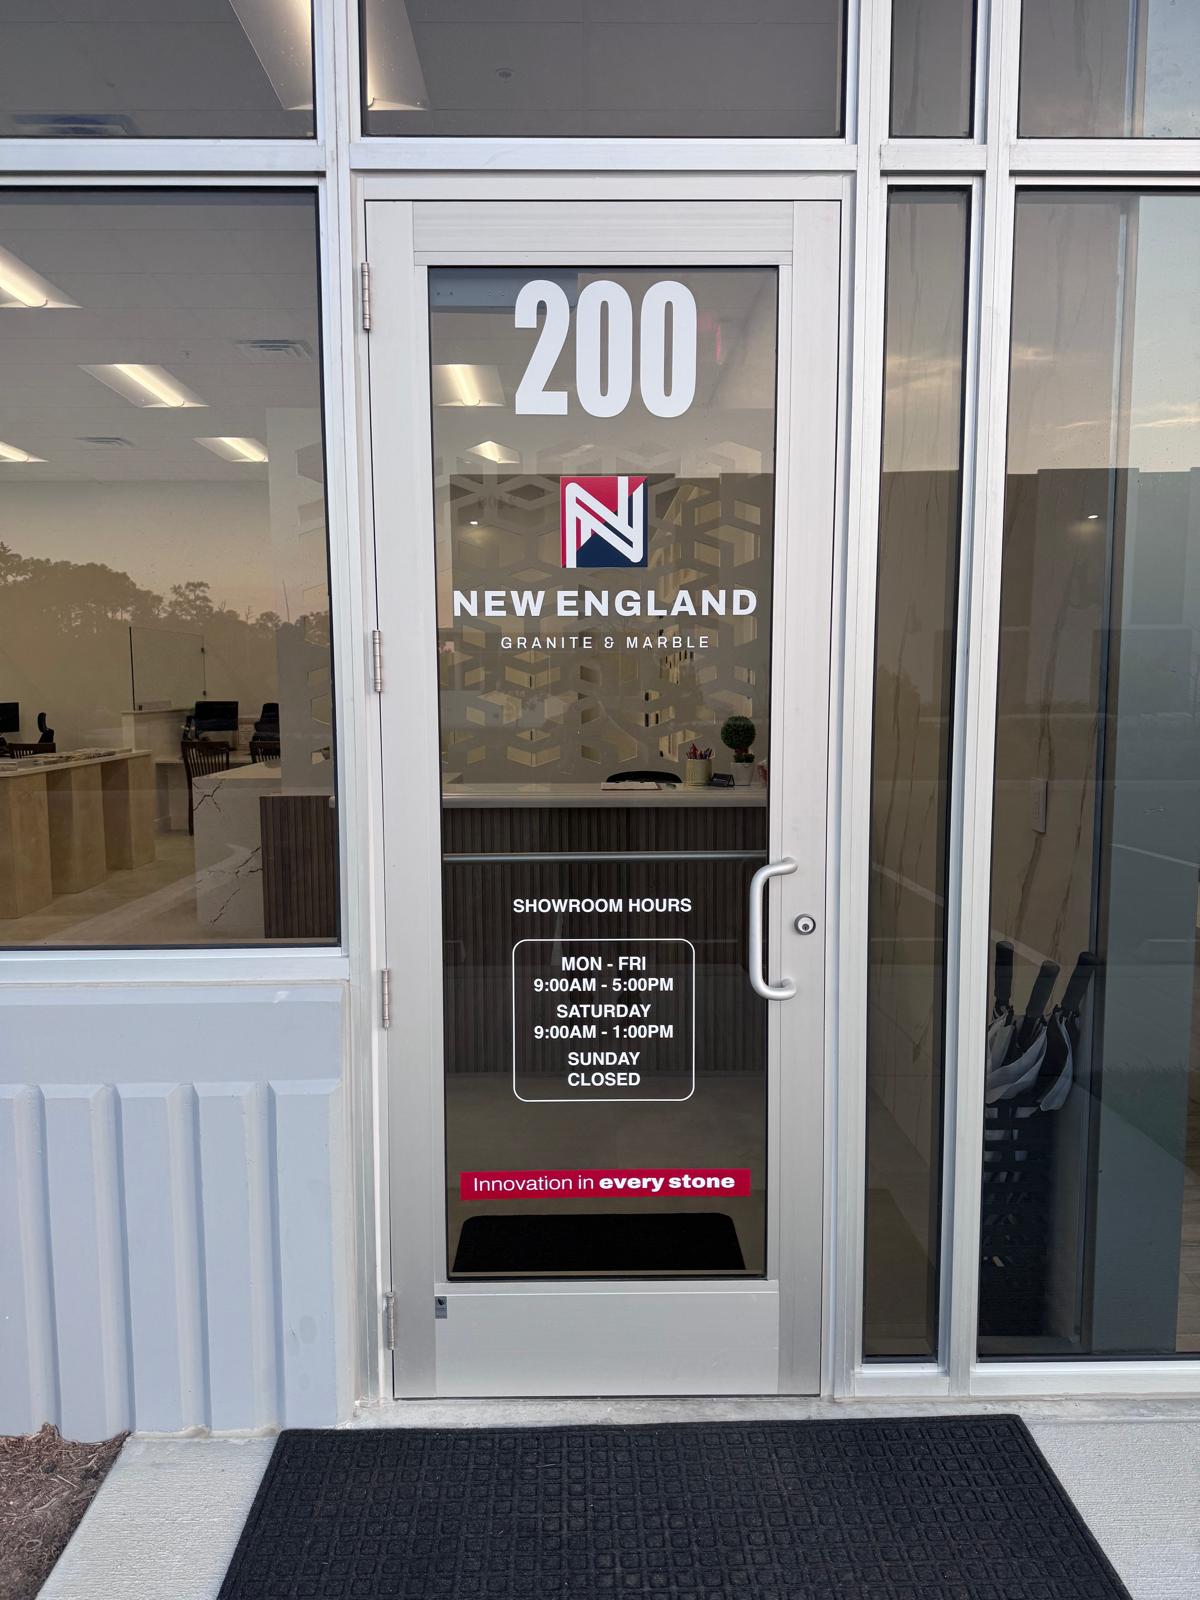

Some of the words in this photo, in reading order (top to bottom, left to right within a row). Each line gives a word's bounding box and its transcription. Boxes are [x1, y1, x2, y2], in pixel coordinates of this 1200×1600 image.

[515, 280, 697, 417] 200
[453, 590, 545, 616] NEW
[556, 589, 756, 616] ENGLAND
[500, 636, 592, 648] GRANITE
[604, 636, 614, 648] &
[626, 635, 708, 648] MARBLE
[513, 898, 622, 912] SHOWROOM
[628, 897, 691, 912] HOURS
[561, 956, 601, 971] MON
[618, 956, 645, 970] FRI
[533, 977, 596, 992] 9:00AM
[612, 977, 673, 991] 5:00PM
[556, 1003, 651, 1018] SATURDAY
[533, 1024, 596, 1039] 9:00AM
[612, 1024, 673, 1038] 1:00PM
[567, 1051, 640, 1065] SUNDAY
[567, 1071, 640, 1086] CLOSED
[474, 1175, 572, 1191] Innovation
[578, 1174, 593, 1189] in
[599, 1177, 664, 1192] every
[668, 1174, 734, 1188] stone
